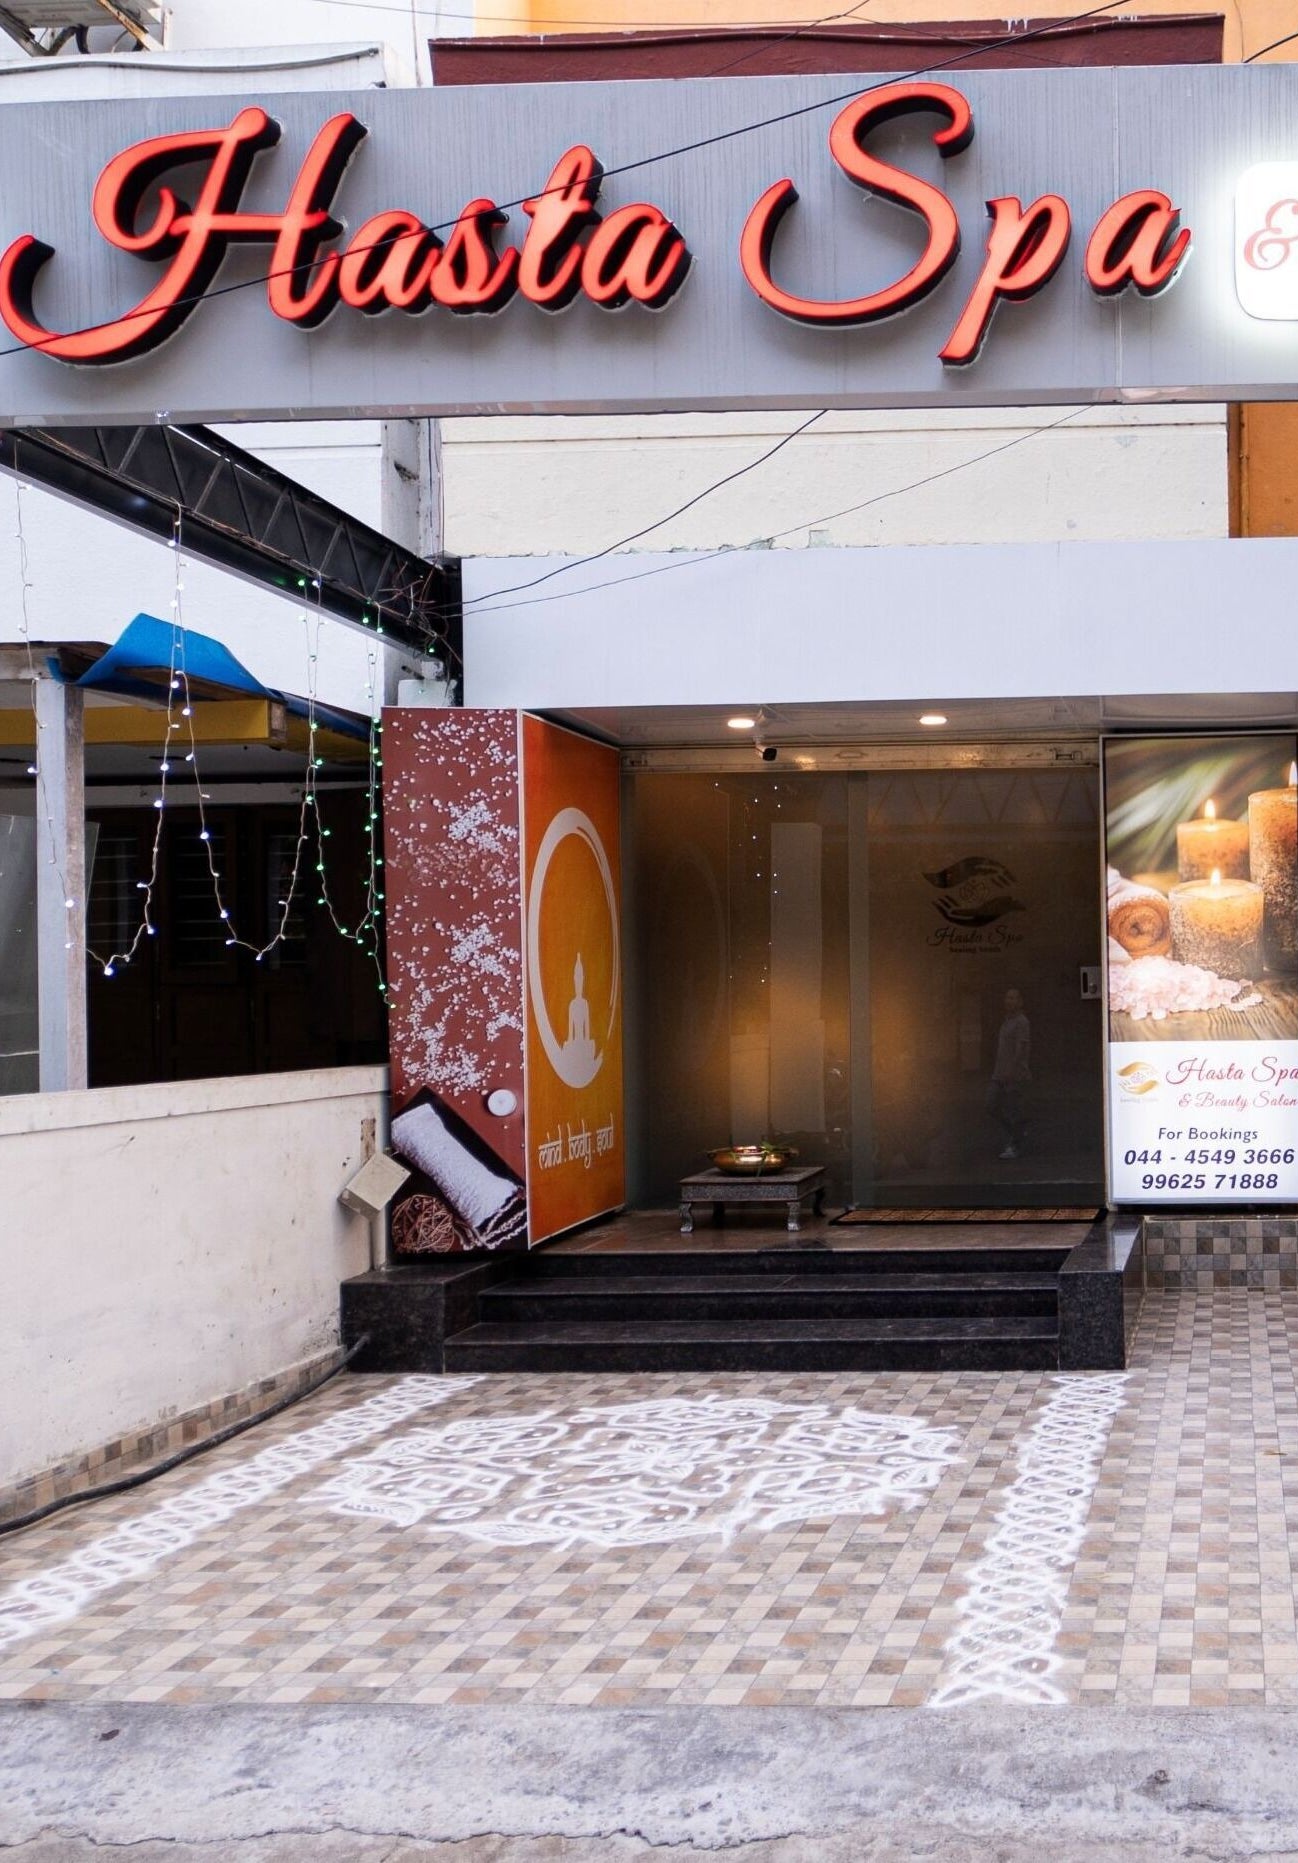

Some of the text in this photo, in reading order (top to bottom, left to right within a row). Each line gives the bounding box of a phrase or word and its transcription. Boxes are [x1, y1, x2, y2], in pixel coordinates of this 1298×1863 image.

[0, 81, 1191, 366] Hasta Spa
[1166, 1057, 1245, 1085] Hasta
[1178, 1093, 1192, 1108] &
[1195, 1091, 1249, 1112] Beauty
[1252, 1090, 1298, 1108] Salon
[538, 1123, 562, 1170] mind
[567, 1119, 592, 1169] body
[1158, 1127, 1258, 1143] For Bookings
[1124, 1150, 1162, 1165] 044
[1184, 1149, 1236, 1165] 4549
[1243, 1149, 1295, 1165] 3666
[1141, 1173, 1278, 1190] 99625 71888
